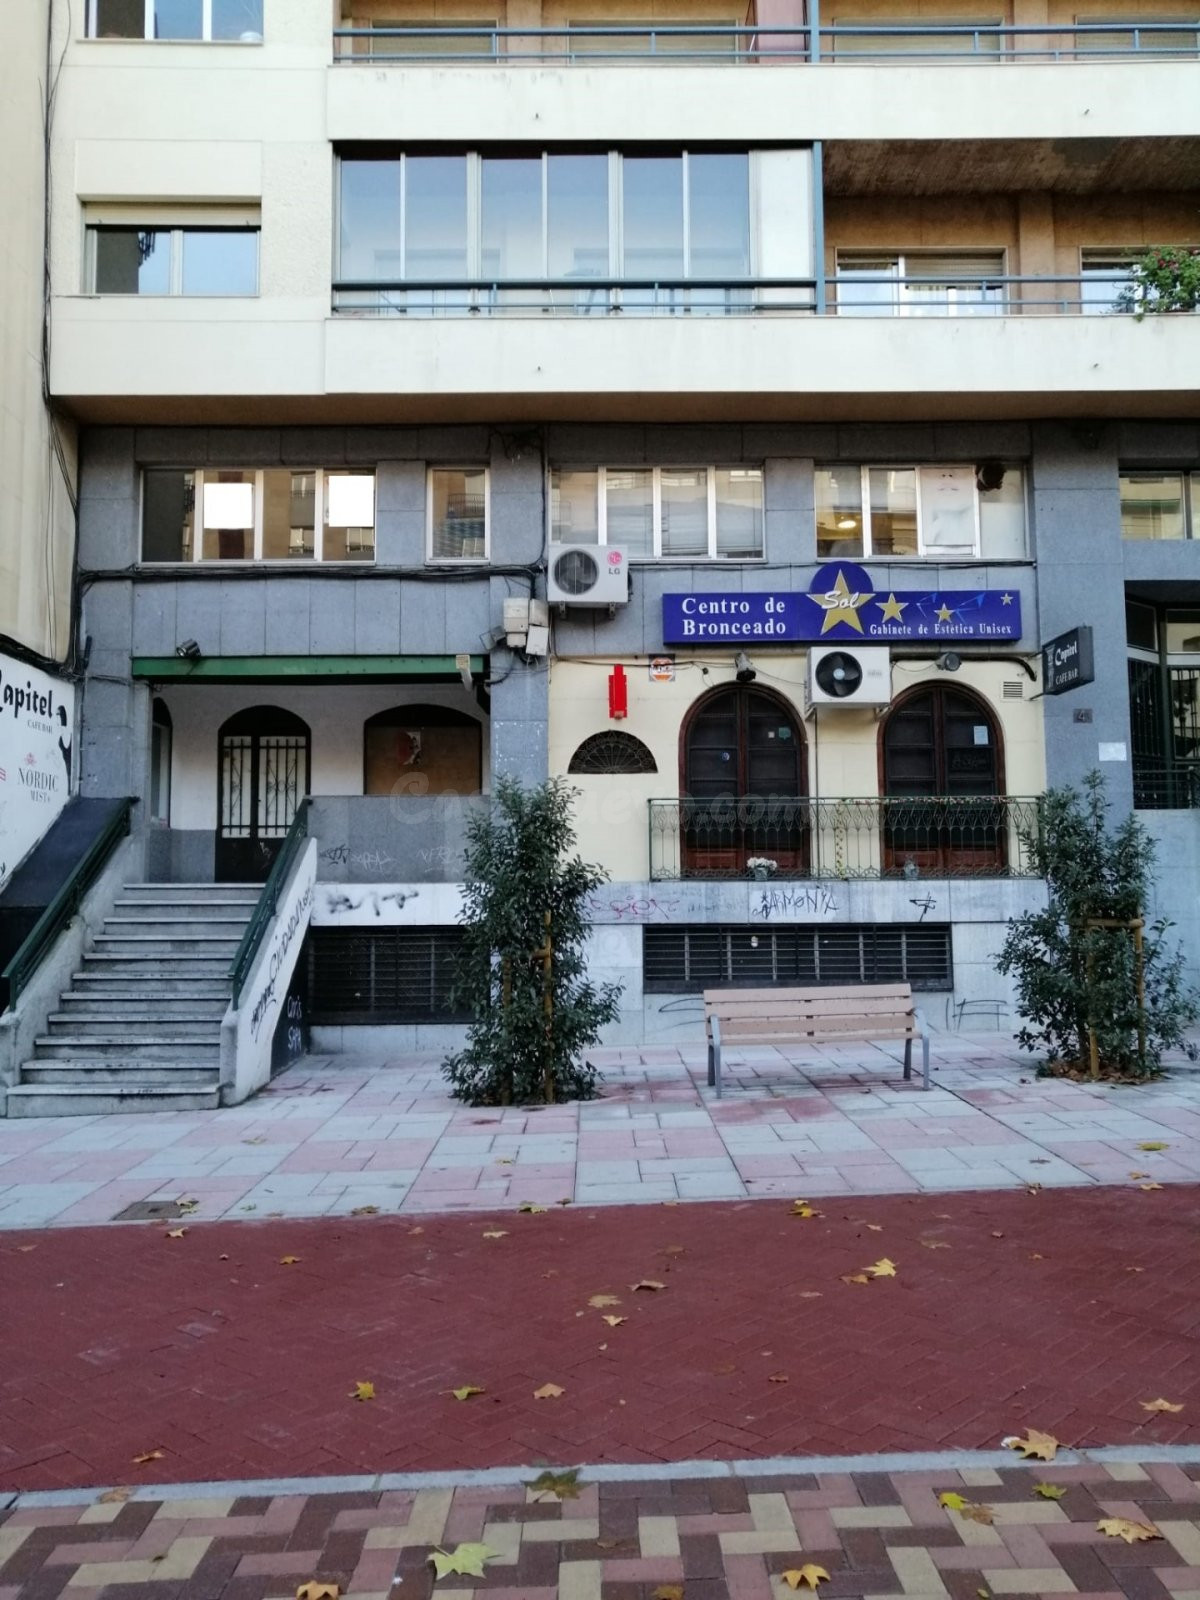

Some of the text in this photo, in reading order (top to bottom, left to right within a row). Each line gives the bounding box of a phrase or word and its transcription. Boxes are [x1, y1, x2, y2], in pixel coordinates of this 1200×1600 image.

[682, 597, 786, 615] Centro de
[821, 590, 861, 611] Sol
[682, 618, 787, 636] Bronceado
[870, 624, 912, 635] Gabinete
[918, 624, 929, 635] de
[980, 622, 1012, 635] Unisex
